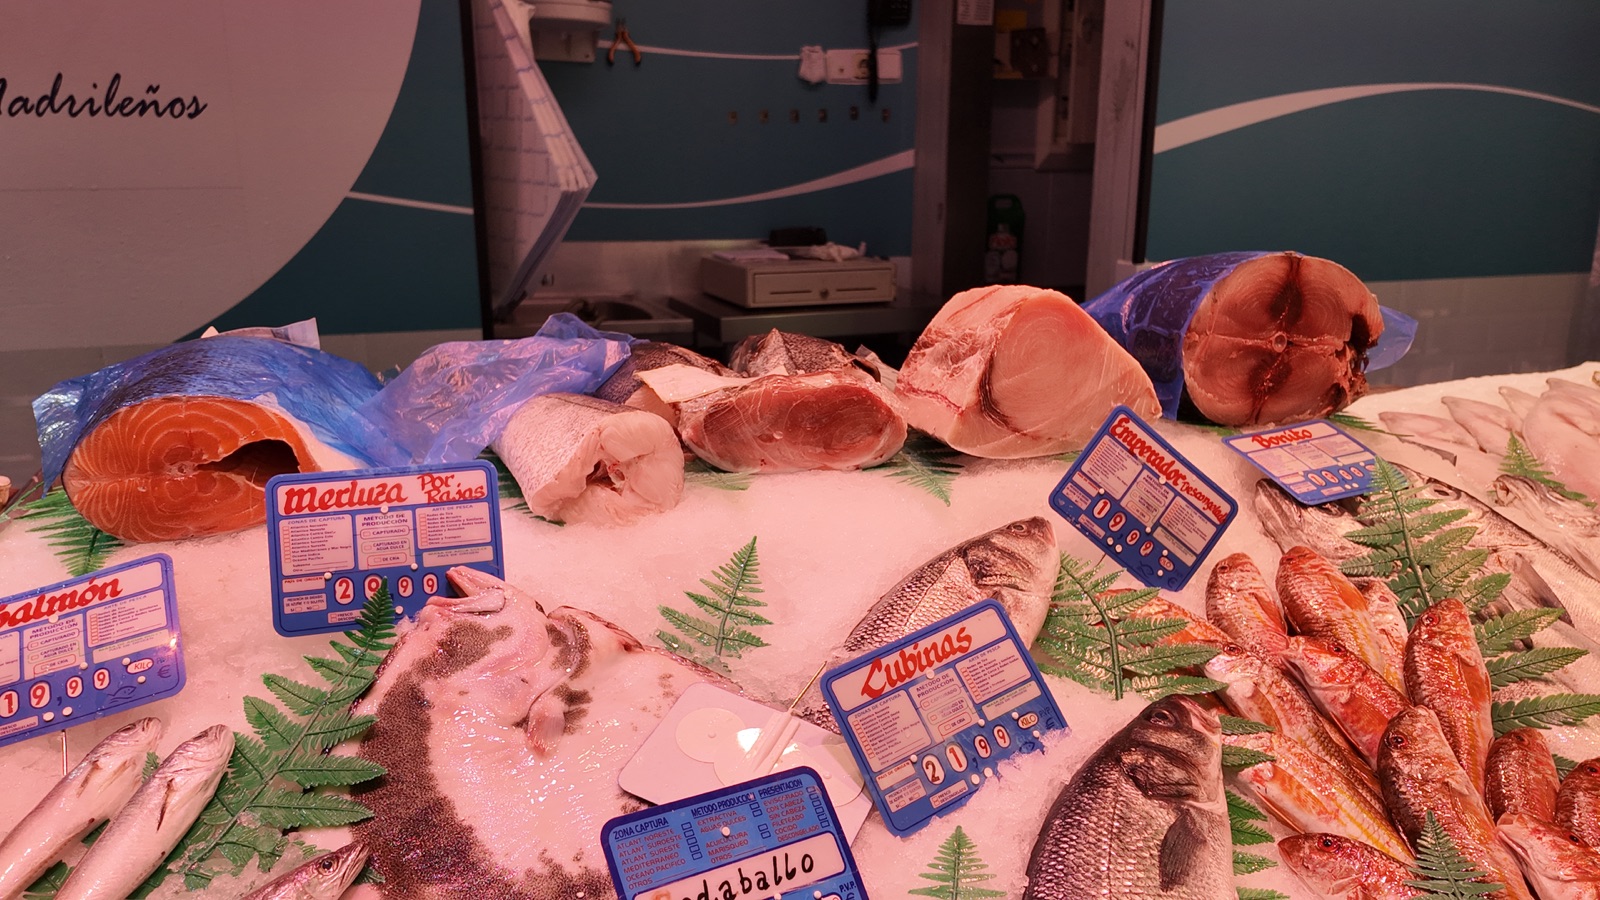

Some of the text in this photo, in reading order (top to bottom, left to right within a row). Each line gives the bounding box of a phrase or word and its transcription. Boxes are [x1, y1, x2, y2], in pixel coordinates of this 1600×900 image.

[0, 72, 208, 119] adrileños
[1252, 428, 1312, 448] Bonito
[1110, 417, 1186, 486] Emperador
[417, 472, 455, 490] Por
[284, 480, 408, 514] Merluza
[424, 483, 485, 504] Rajas
[40, 631, 75, 644] CAPTURADO
[861, 626, 973, 700] Lubinas
[1020, 714, 1037, 727] KILO
[758, 779, 802, 796] PRESENTACION
[690, 802, 717, 816] METODO
[765, 797, 804, 813] CON CABEZA
[780, 805, 806, 816] CABEZA
[697, 810, 736, 825] EXTRACTIVA
[771, 813, 804, 826] FILETEADO
[612, 817, 668, 839] ZONA CAPTURA
[774, 823, 797, 835] COCIDO
[646, 834, 681, 849] SUROESTE
[649, 842, 679, 857] SURESTE
[707, 839, 748, 855] MARISQUEO
[623, 851, 678, 873] MEDITERRANEO
[710, 852, 732, 863] OTROS
[625, 858, 685, 882] OCEANO PACIFICO
[628, 877, 652, 890] OTROS
